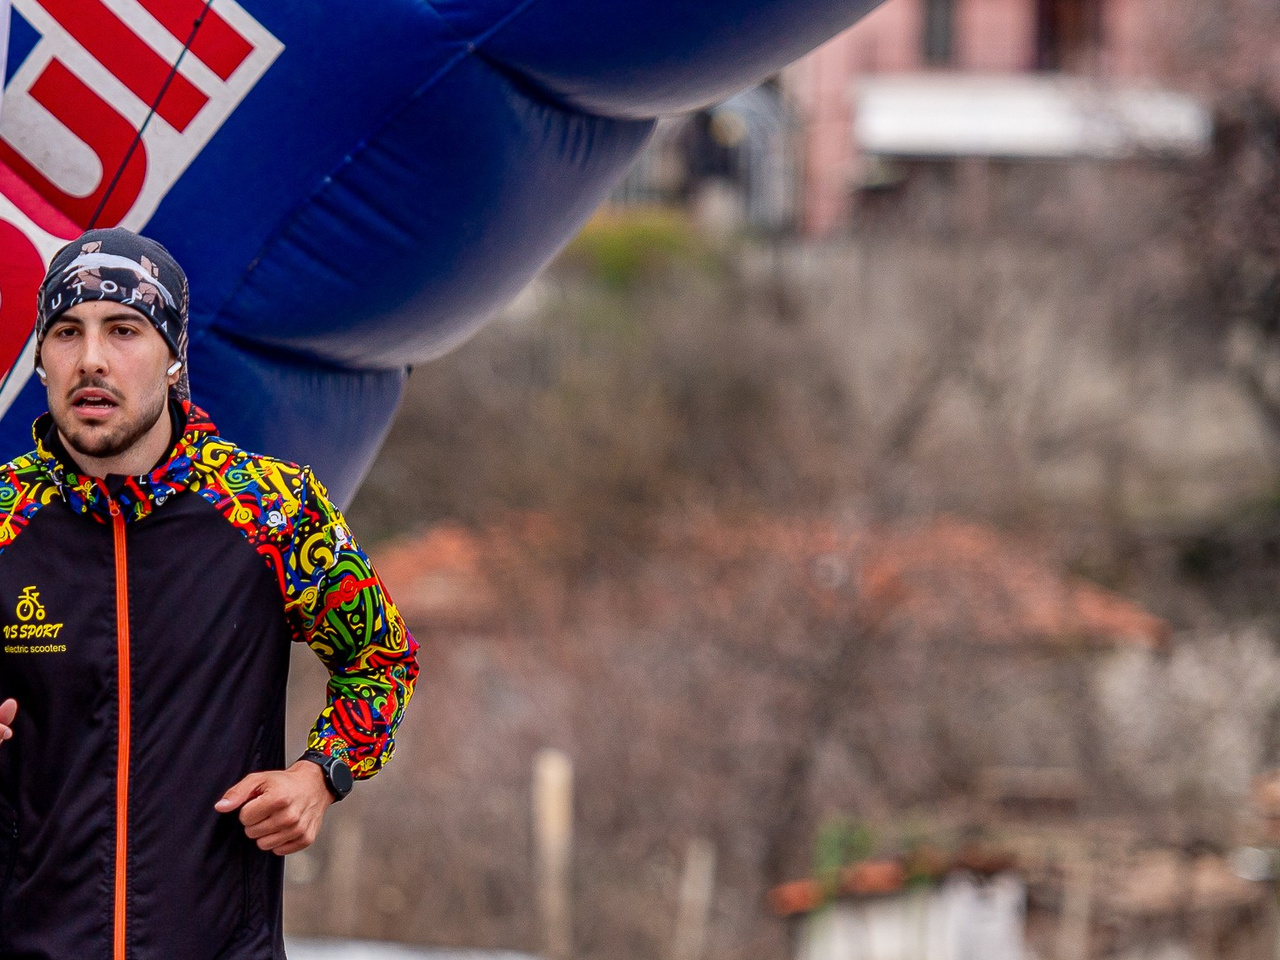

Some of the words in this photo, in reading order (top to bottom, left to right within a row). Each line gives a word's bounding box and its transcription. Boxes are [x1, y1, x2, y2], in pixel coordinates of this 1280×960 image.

[51, 280, 168, 333] UTOPIA
[19, 623, 64, 640] SPORT
[4, 644, 29, 654] electric
[30, 644, 67, 653] scooters
